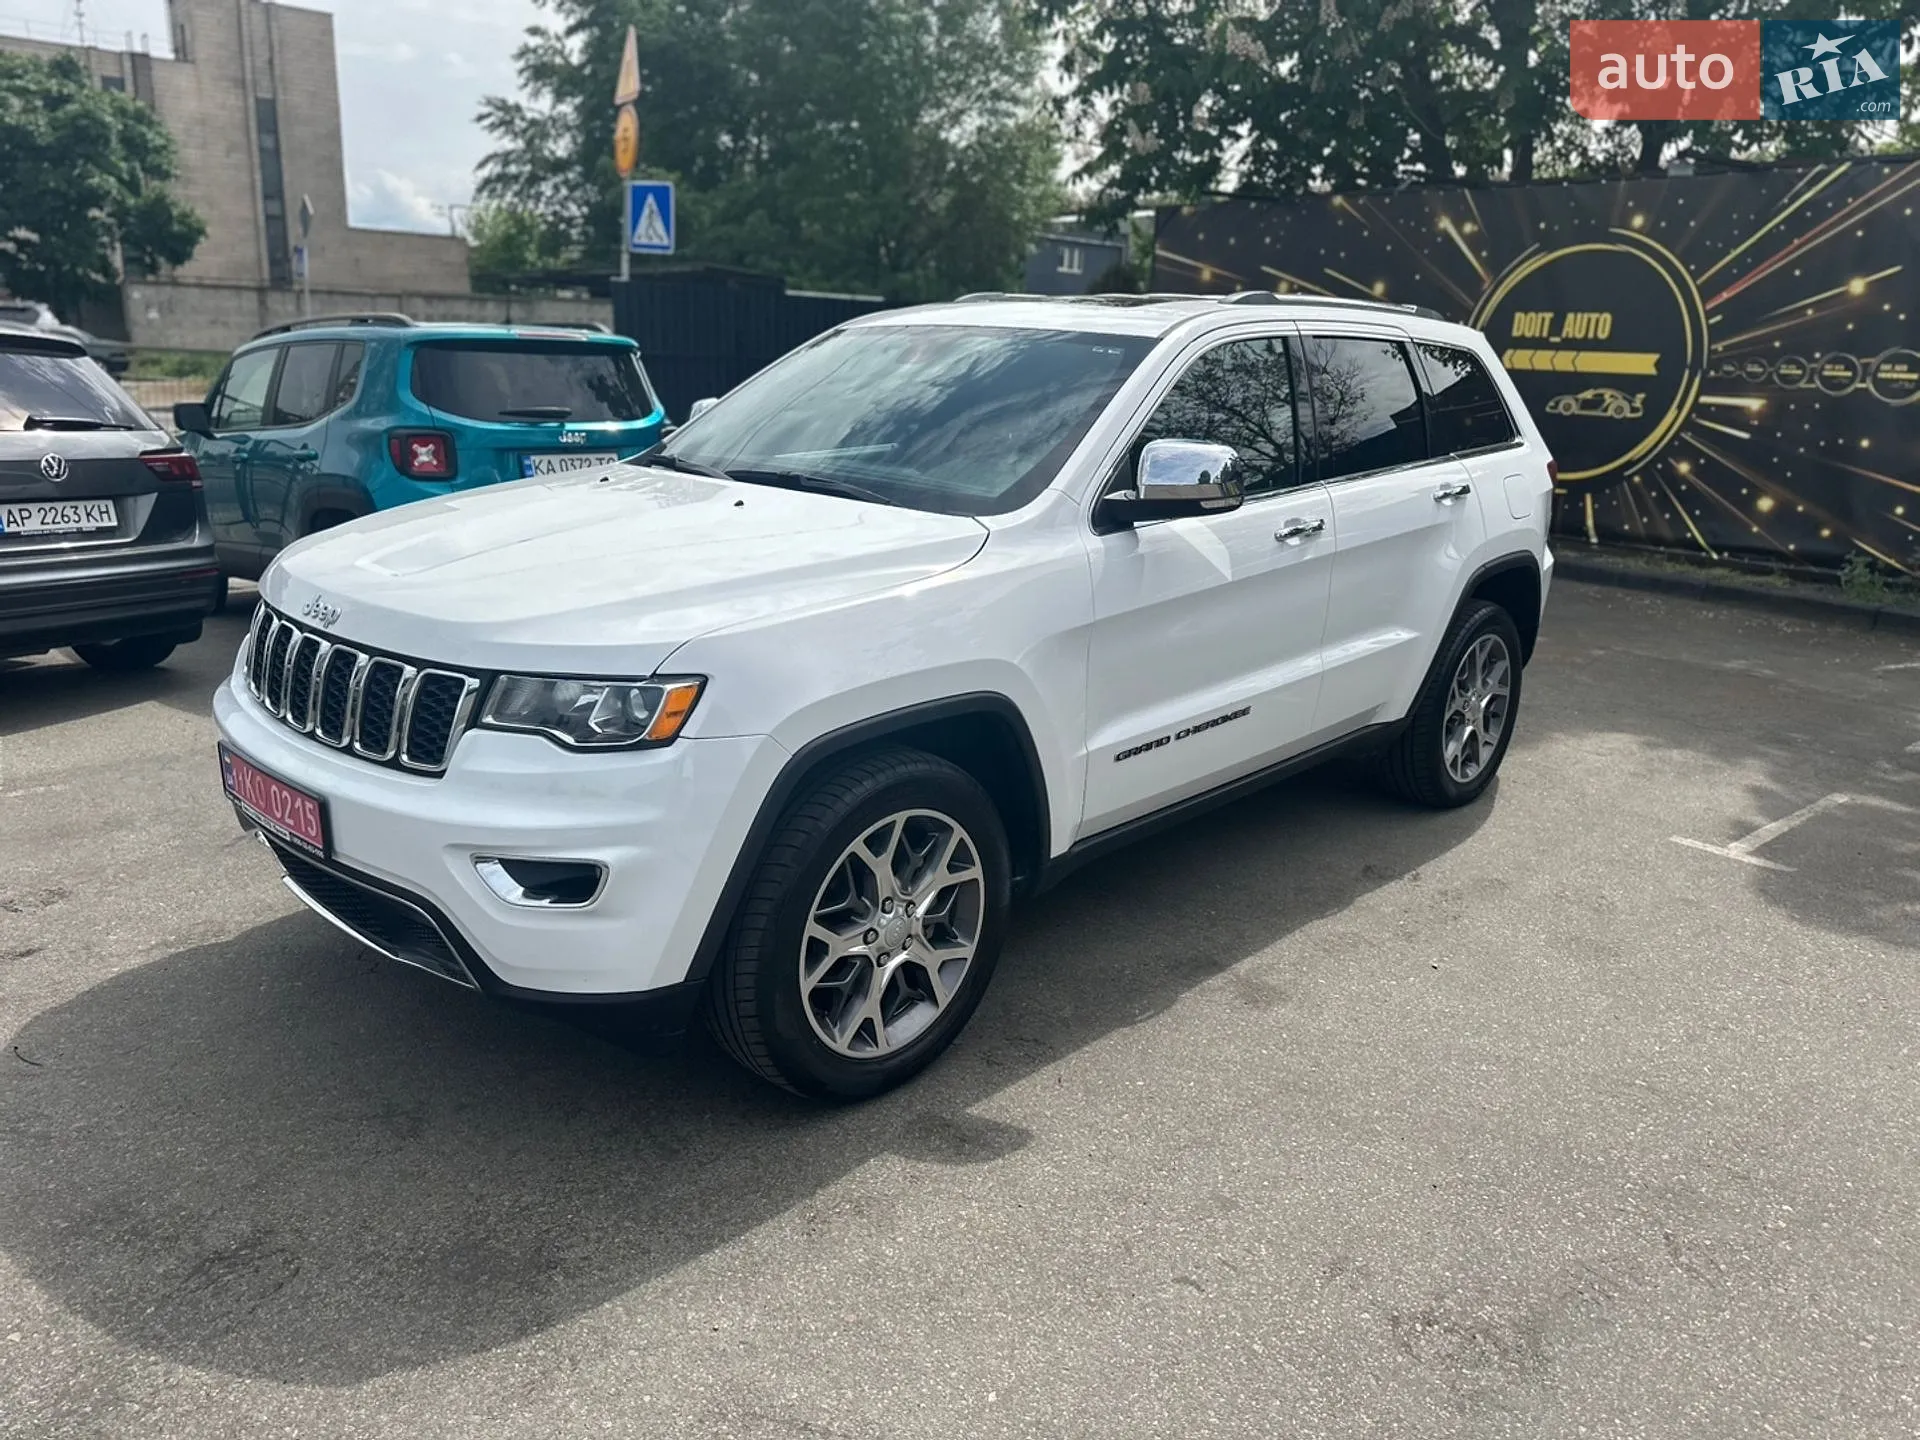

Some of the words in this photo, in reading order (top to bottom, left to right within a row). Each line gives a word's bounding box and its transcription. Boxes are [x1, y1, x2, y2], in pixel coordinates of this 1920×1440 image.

[1511, 311, 1612, 342] DOIT_AUTO
[533, 457, 557, 476] KA
[6, 508, 32, 528] AP
[37, 505, 82, 526] 2263
[84, 504, 112, 523] KH
[302, 594, 343, 629] Jeep
[1113, 735, 1171, 763] GRAND
[1174, 706, 1252, 741] CHEROKEE
[271, 784, 317, 837] 0215
